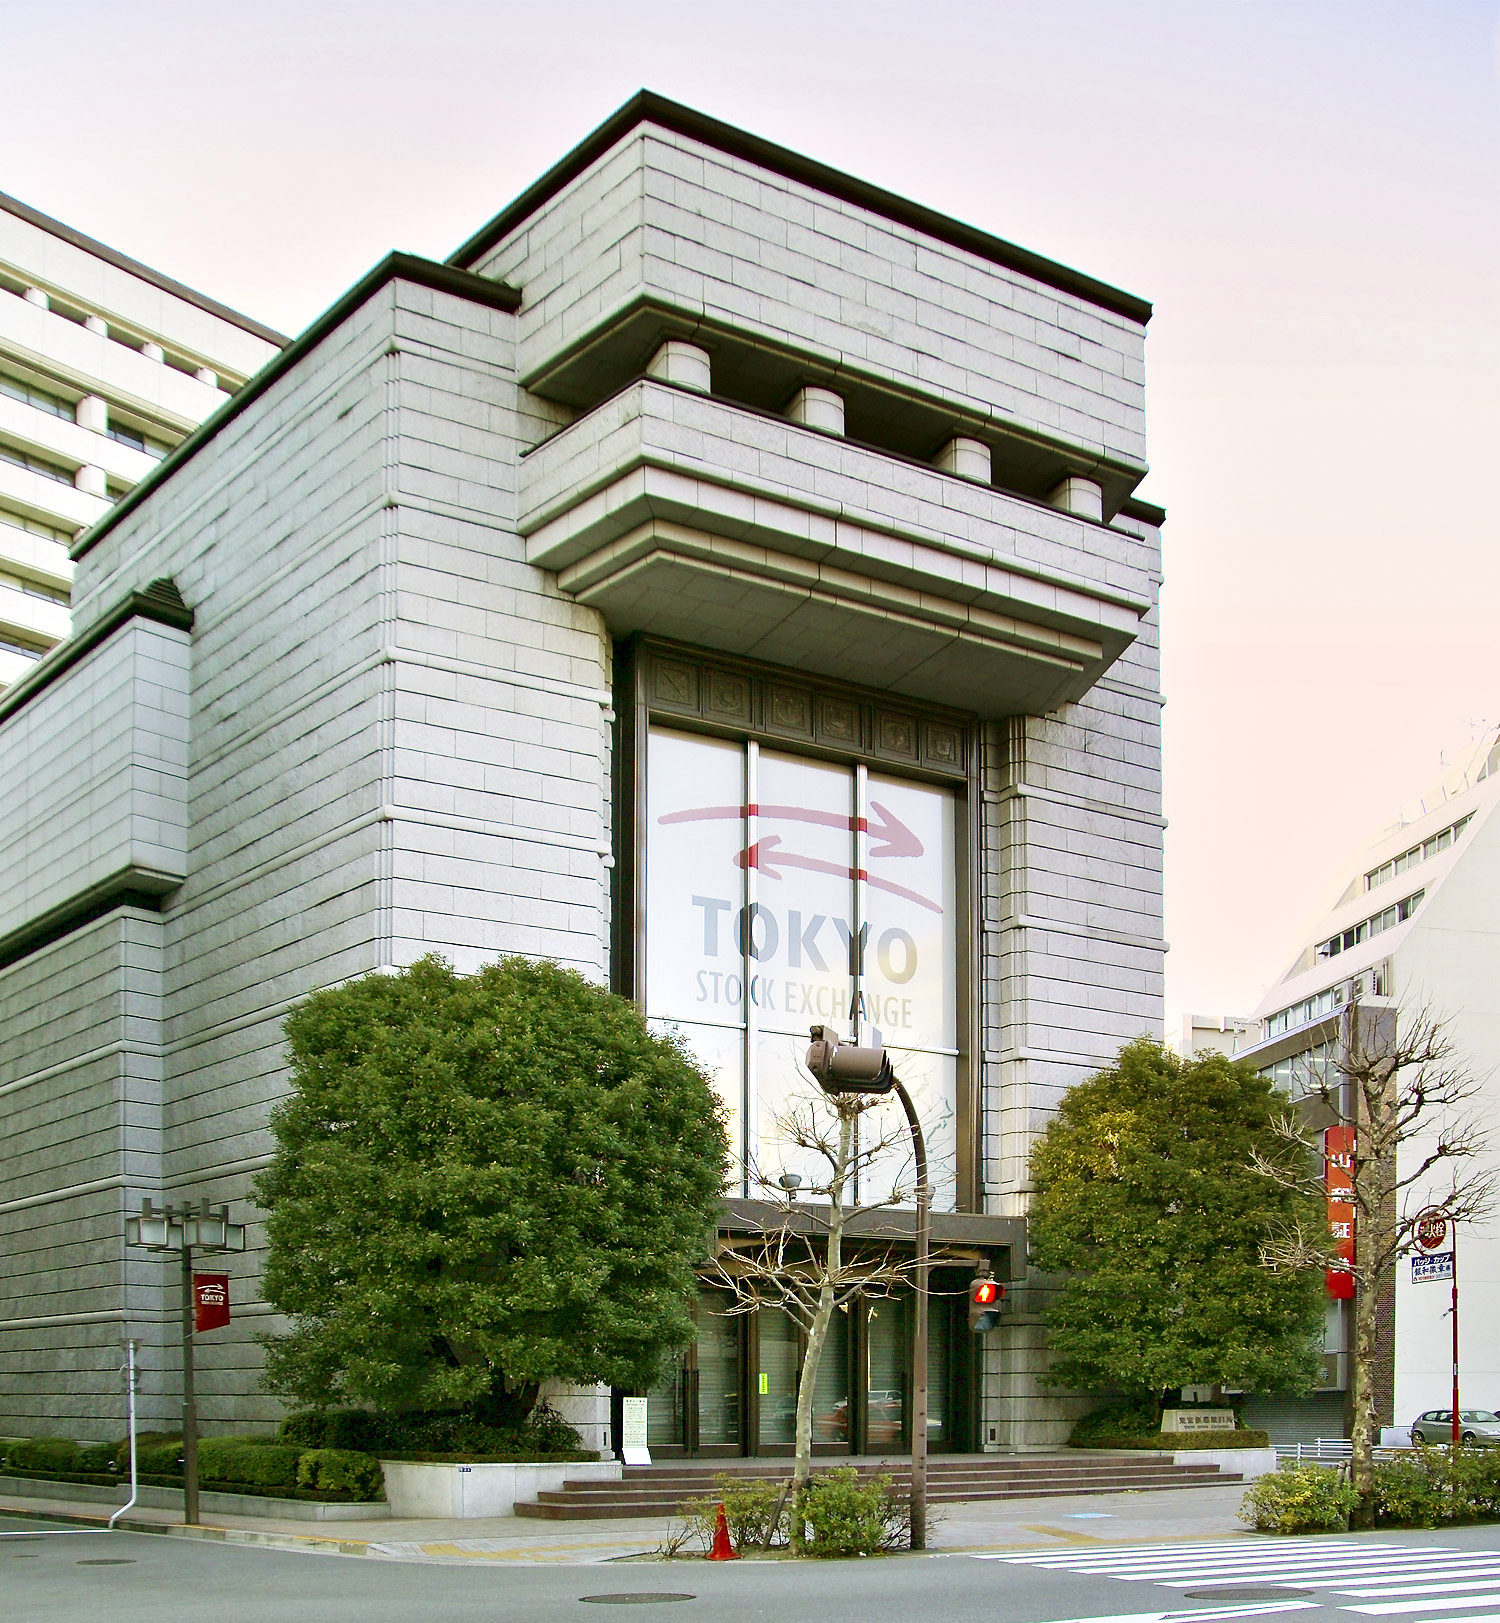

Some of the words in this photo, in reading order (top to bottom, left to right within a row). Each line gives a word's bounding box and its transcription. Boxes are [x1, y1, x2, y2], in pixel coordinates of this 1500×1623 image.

[691, 894, 918, 985] TOKYO
[696, 969, 776, 1011] STOCK
[785, 981, 913, 1029] EXCHANGE
